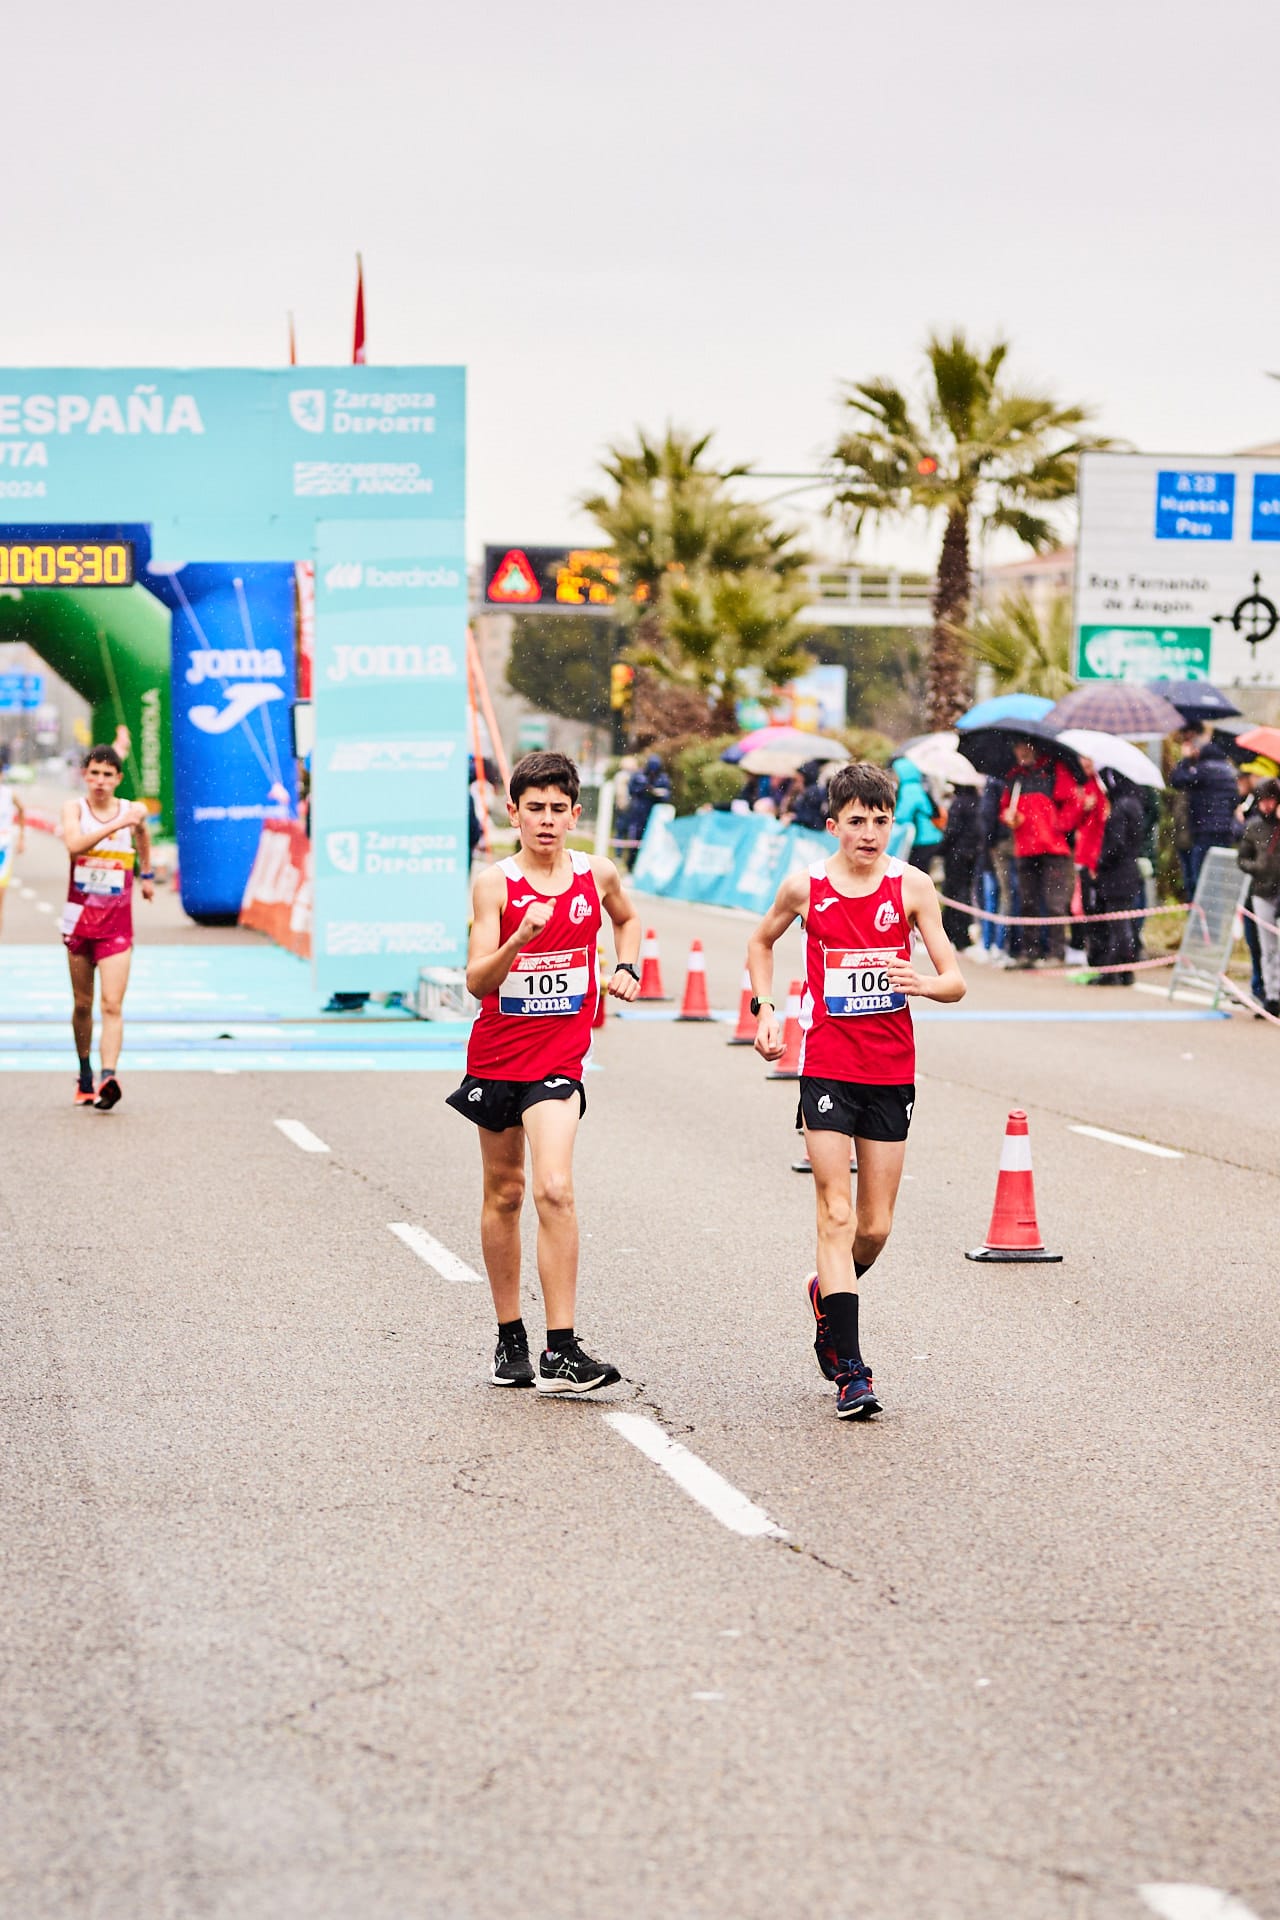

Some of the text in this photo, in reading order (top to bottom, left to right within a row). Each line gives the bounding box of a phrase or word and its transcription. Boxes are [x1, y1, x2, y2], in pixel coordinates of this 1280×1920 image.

[0, 384, 206, 435] ESPAÑA
[333, 388, 437, 414] Zaragoza
[333, 412, 437, 433] DEPORTE
[524, 973, 568, 995] 105
[847, 971, 890, 993] 106
